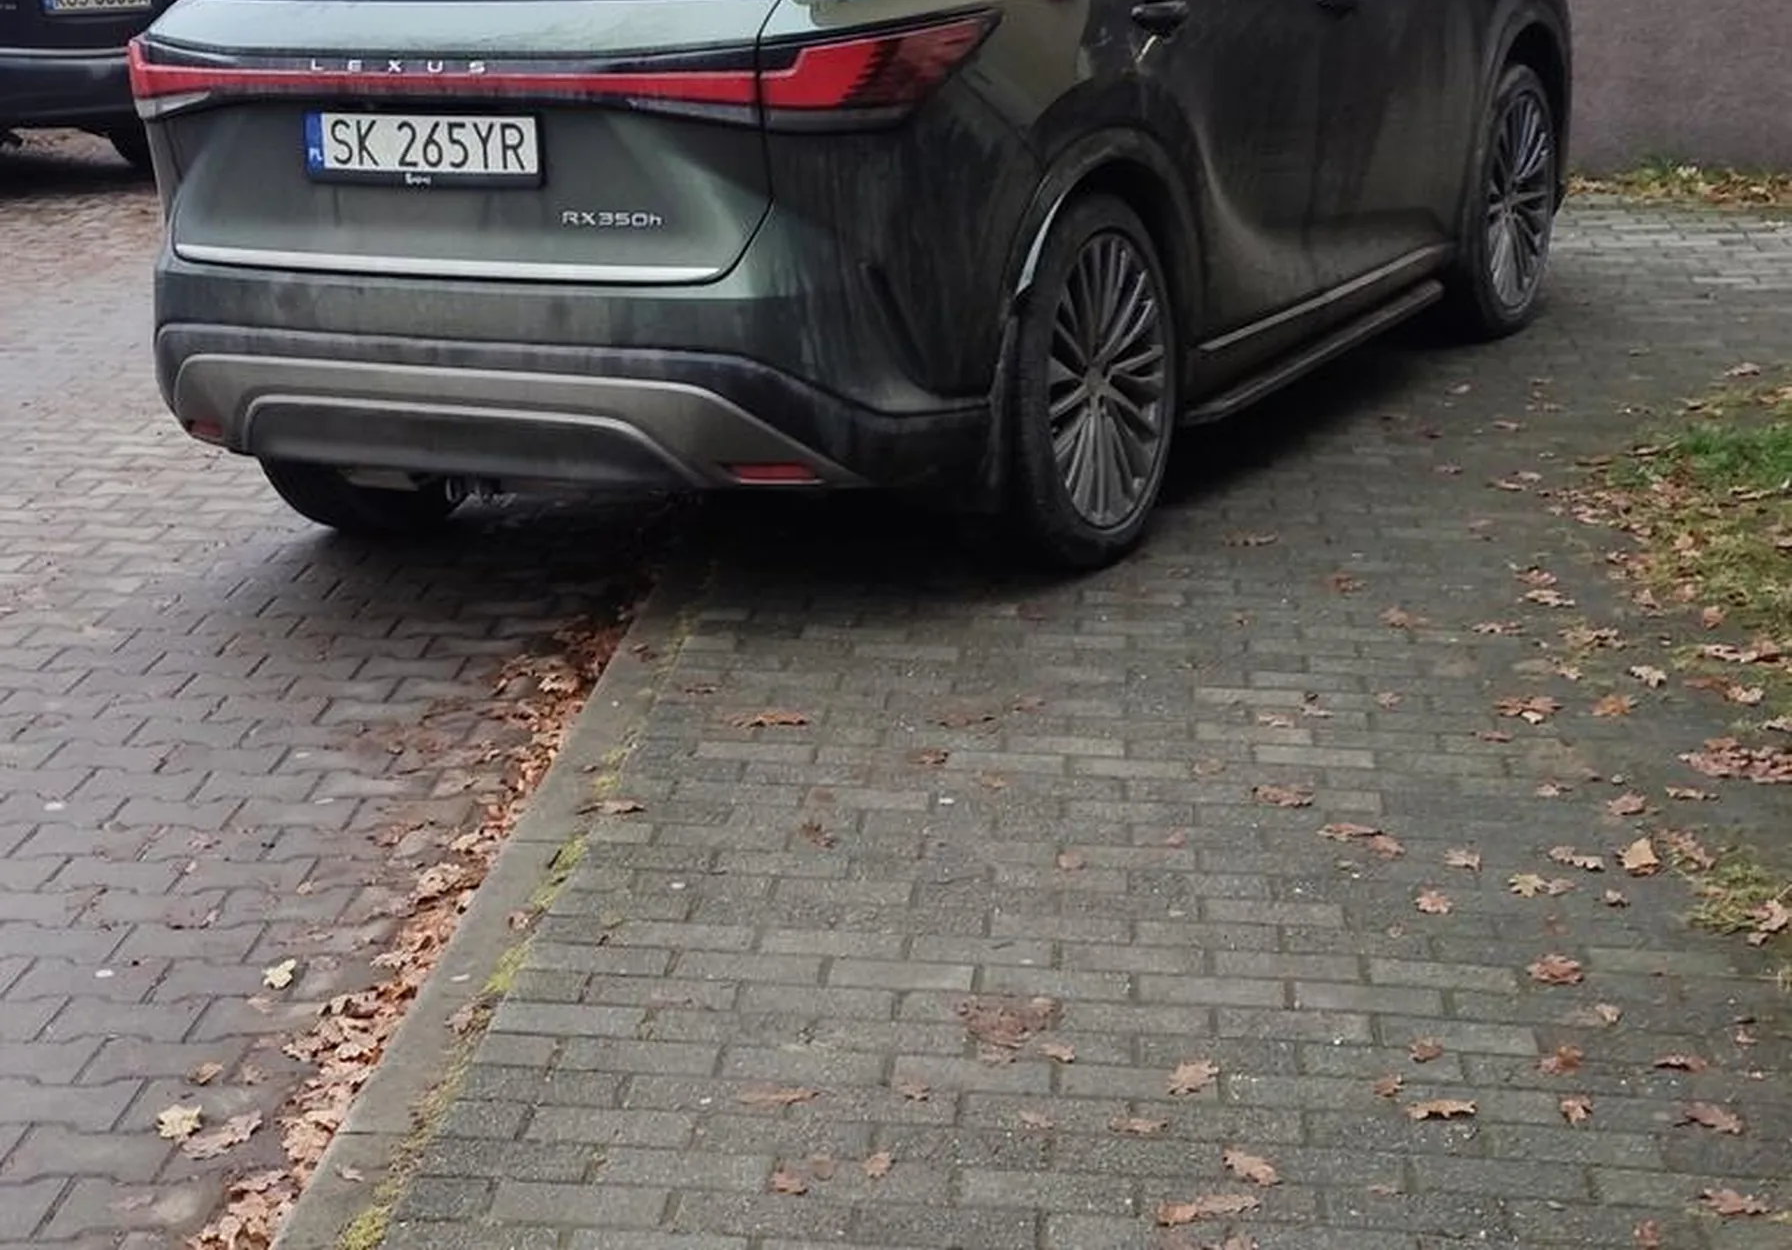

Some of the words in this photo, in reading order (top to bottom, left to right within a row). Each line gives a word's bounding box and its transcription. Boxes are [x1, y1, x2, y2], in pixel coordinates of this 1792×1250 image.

[310, 58, 486, 74] LEXUS
[331, 119, 379, 167] SK
[397, 121, 526, 171] 265YR
[561, 210, 663, 228] RX350h
